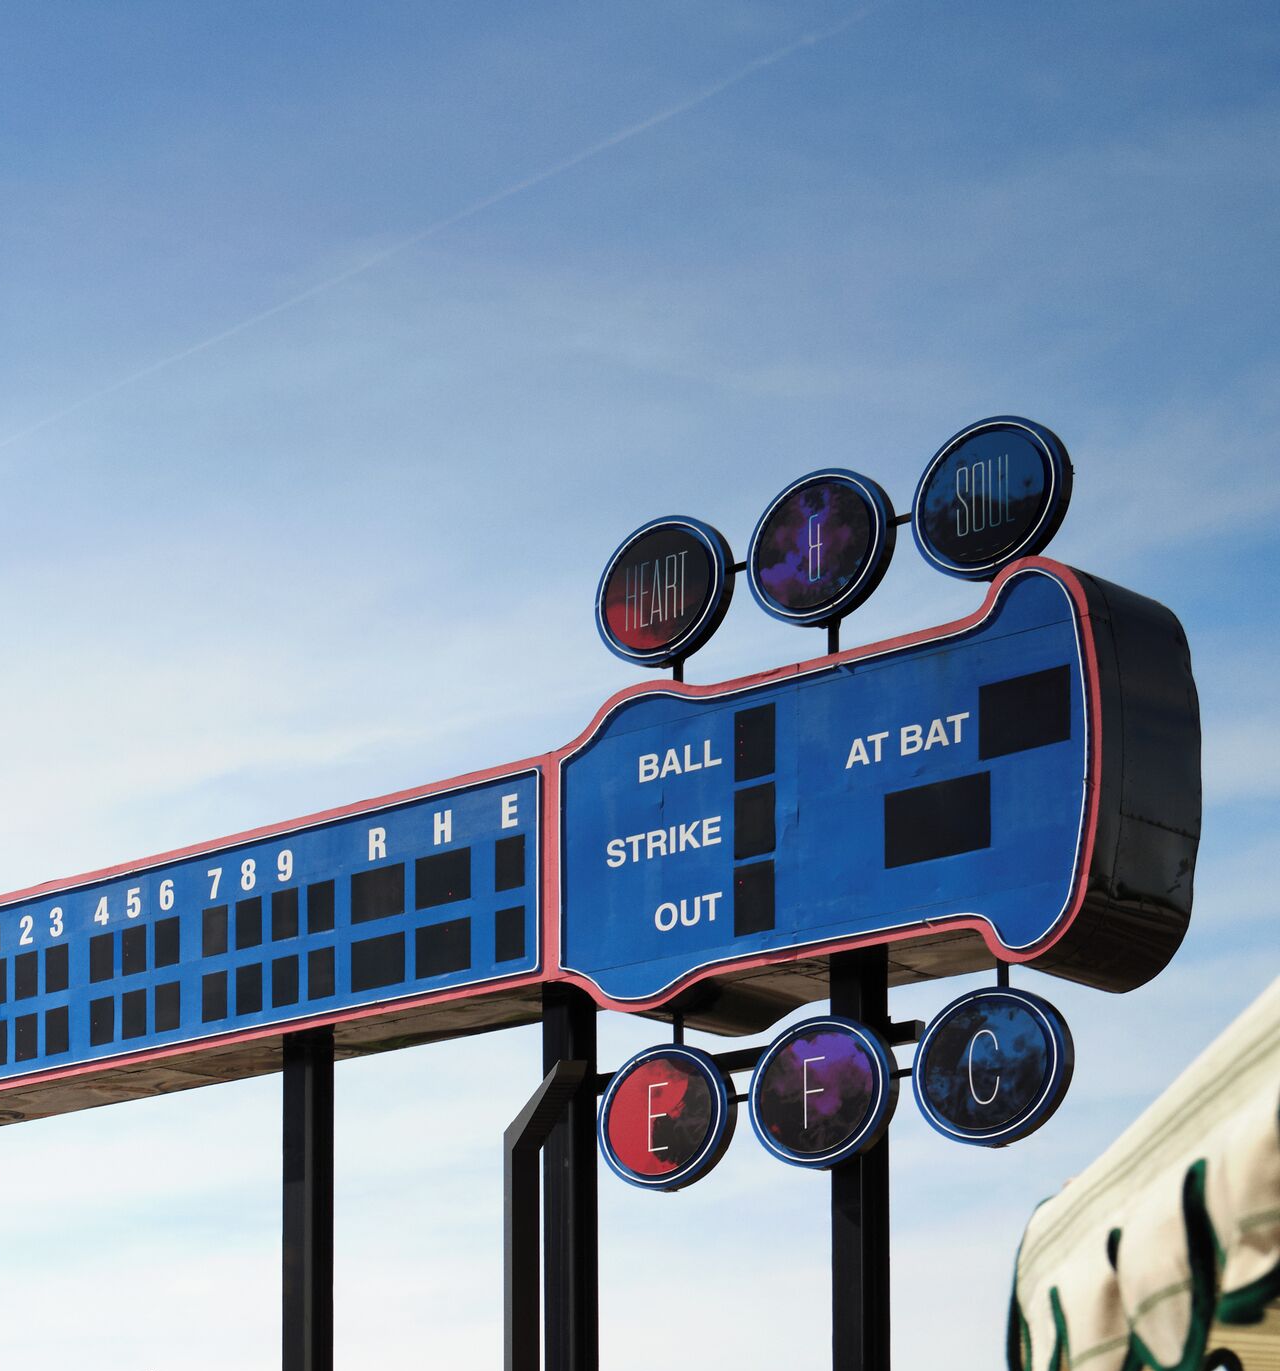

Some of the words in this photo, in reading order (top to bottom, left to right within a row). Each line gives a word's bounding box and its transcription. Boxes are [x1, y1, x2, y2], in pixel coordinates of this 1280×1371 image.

[624, 551, 689, 632] HEART
[956, 454, 1015, 537] SOUL
[638, 740, 722, 784] BALL
[844, 734, 888, 769] AT
[899, 713, 970, 757] BAT
[18, 915, 34, 946] 2
[49, 907, 64, 937] 3
[94, 896, 110, 926] 4
[126, 887, 141, 919] 5
[159, 879, 175, 911] 6
[208, 868, 223, 900] 7
[241, 858, 257, 891] 8
[277, 849, 294, 883] 9
[368, 827, 387, 862] R
[433, 809, 452, 846] H
[501, 793, 519, 829] E
[605, 816, 722, 869] STRIKE
[654, 892, 723, 932] OUT
[648, 1082, 669, 1152] E
[803, 1056, 826, 1130] F
[968, 1029, 1000, 1105] C
